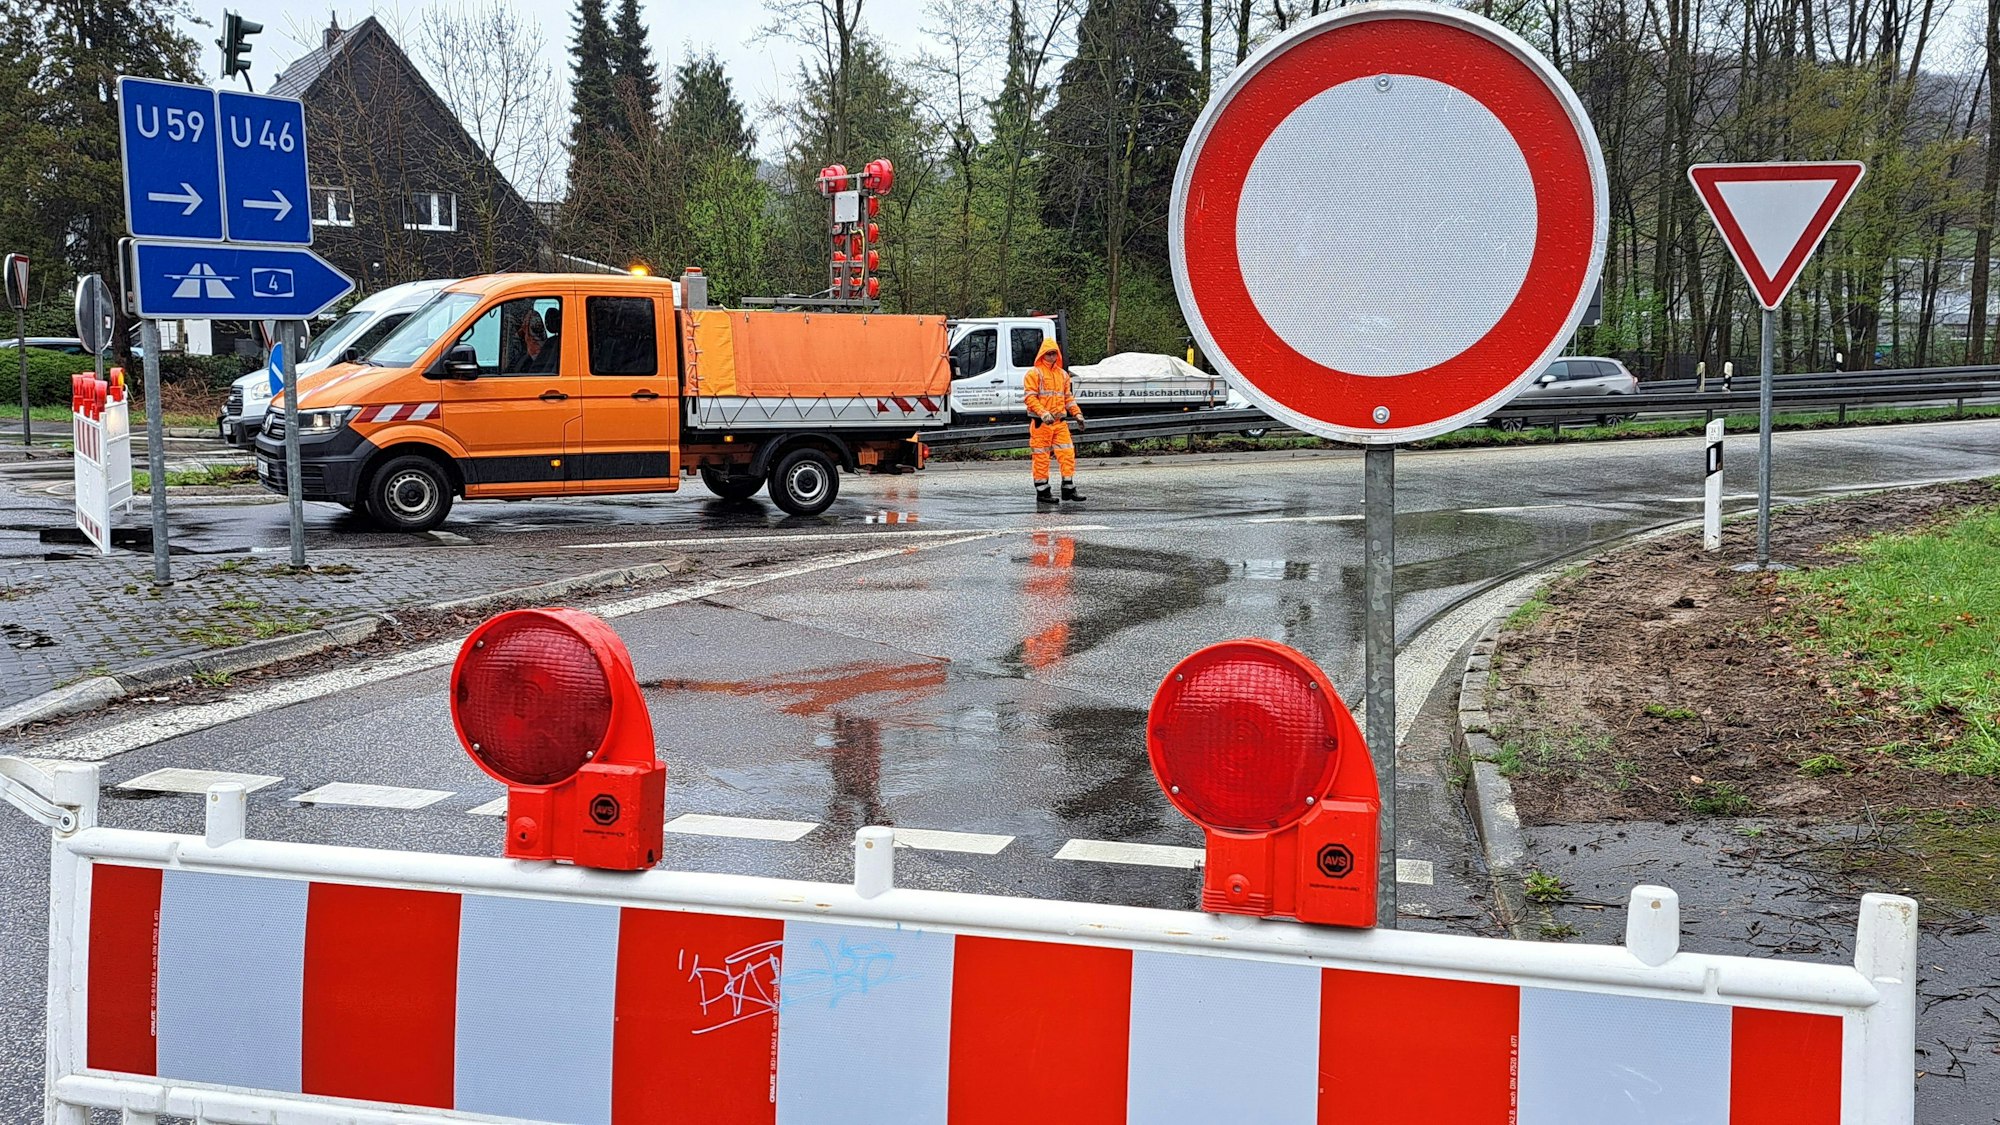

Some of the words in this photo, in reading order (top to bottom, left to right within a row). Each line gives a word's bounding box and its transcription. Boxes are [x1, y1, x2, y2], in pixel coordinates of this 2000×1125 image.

[136, 104, 160, 138] U
[166, 107, 205, 143] 59
[230, 115, 253, 148] U
[258, 119, 295, 153] 46
[268, 274, 278, 291] 4
[1080, 389, 1114, 398] Abriss
[1117, 389, 1125, 397] &
[1129, 388, 1220, 398] Ausschachtungen
[596, 805, 614, 816] AVS
[1324, 855, 1347, 867] AVS
